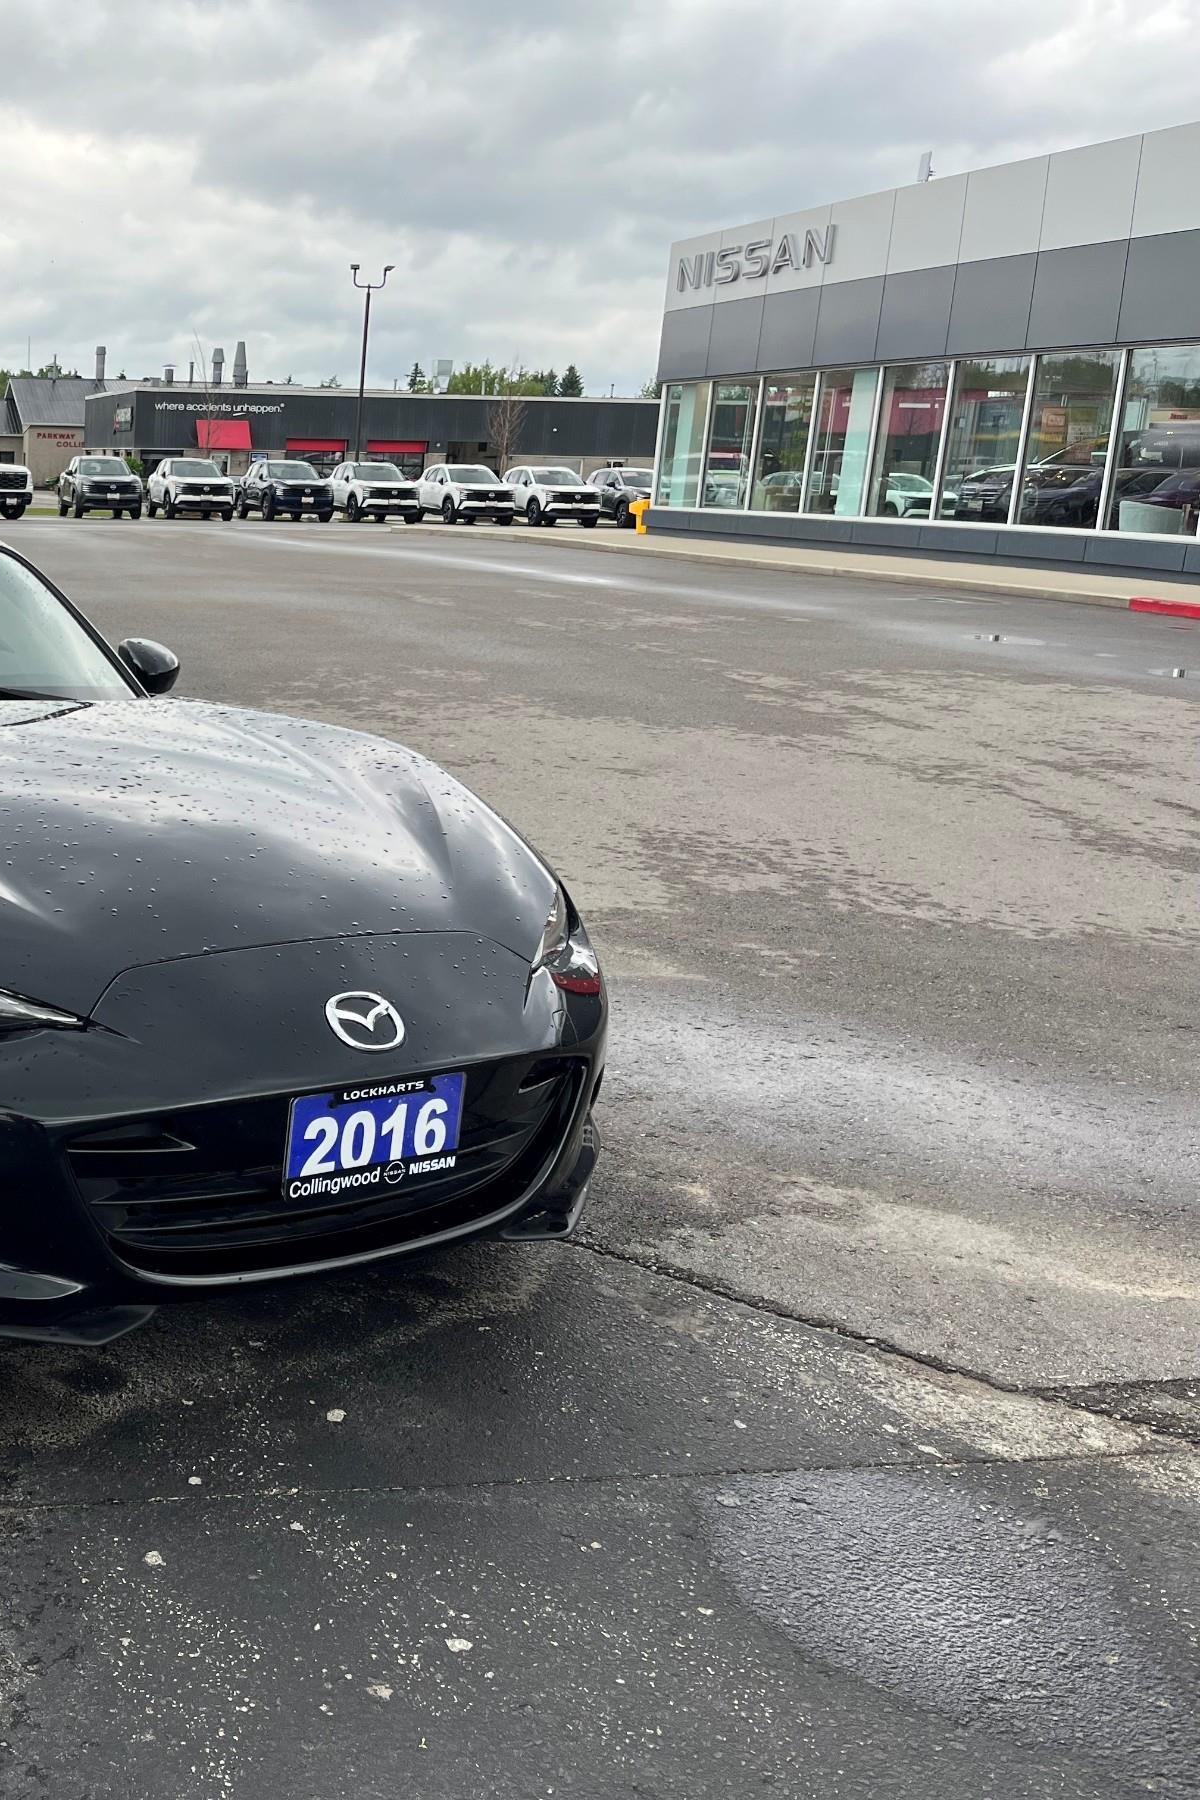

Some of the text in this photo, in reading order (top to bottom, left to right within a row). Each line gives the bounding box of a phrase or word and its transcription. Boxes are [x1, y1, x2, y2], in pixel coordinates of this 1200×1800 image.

[677, 224, 836, 292] NISSAN
[154, 401, 185, 411] where
[186, 401, 231, 412] accidents
[36, 432, 76, 440] PARKWAY
[300, 1098, 448, 1177] 2016
[289, 1166, 380, 1198] Collingwood
[408, 1156, 456, 1175] NISSAN
